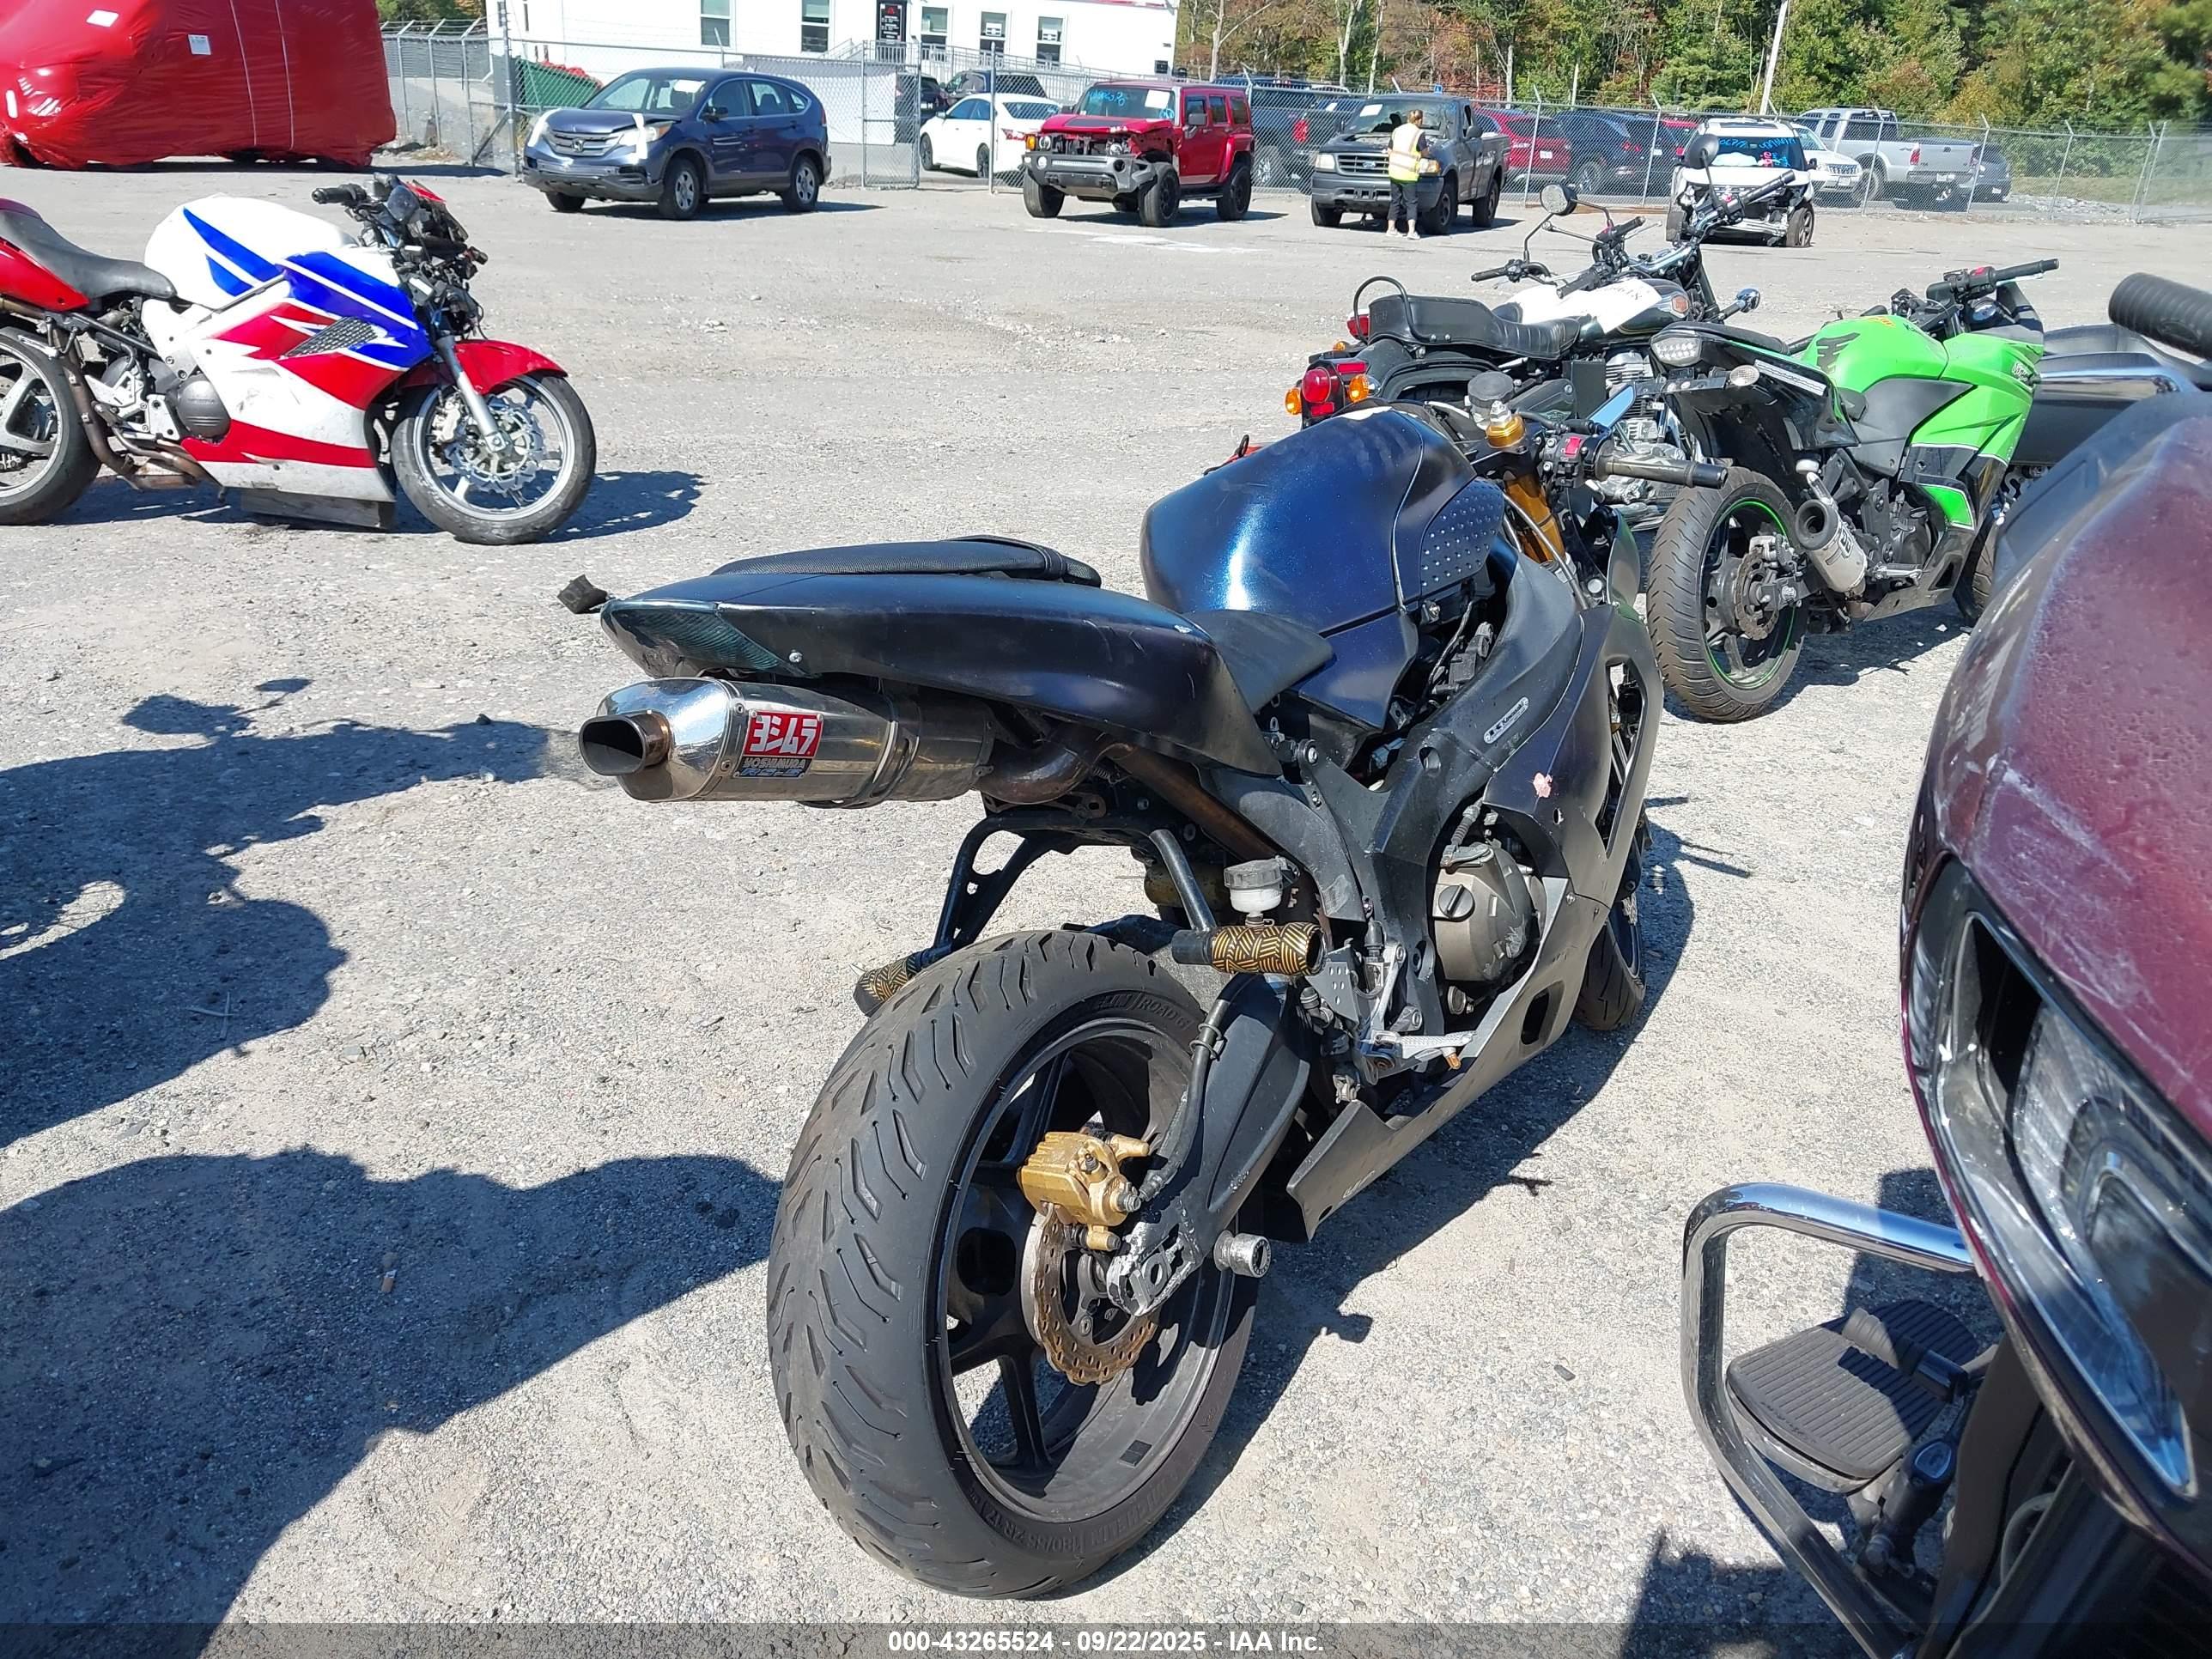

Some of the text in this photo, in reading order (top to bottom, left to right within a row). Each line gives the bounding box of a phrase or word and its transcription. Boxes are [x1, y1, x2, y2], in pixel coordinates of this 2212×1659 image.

[750, 714, 818, 754] ヨシムラ
[743, 758, 806, 769] YOSHIMURA
